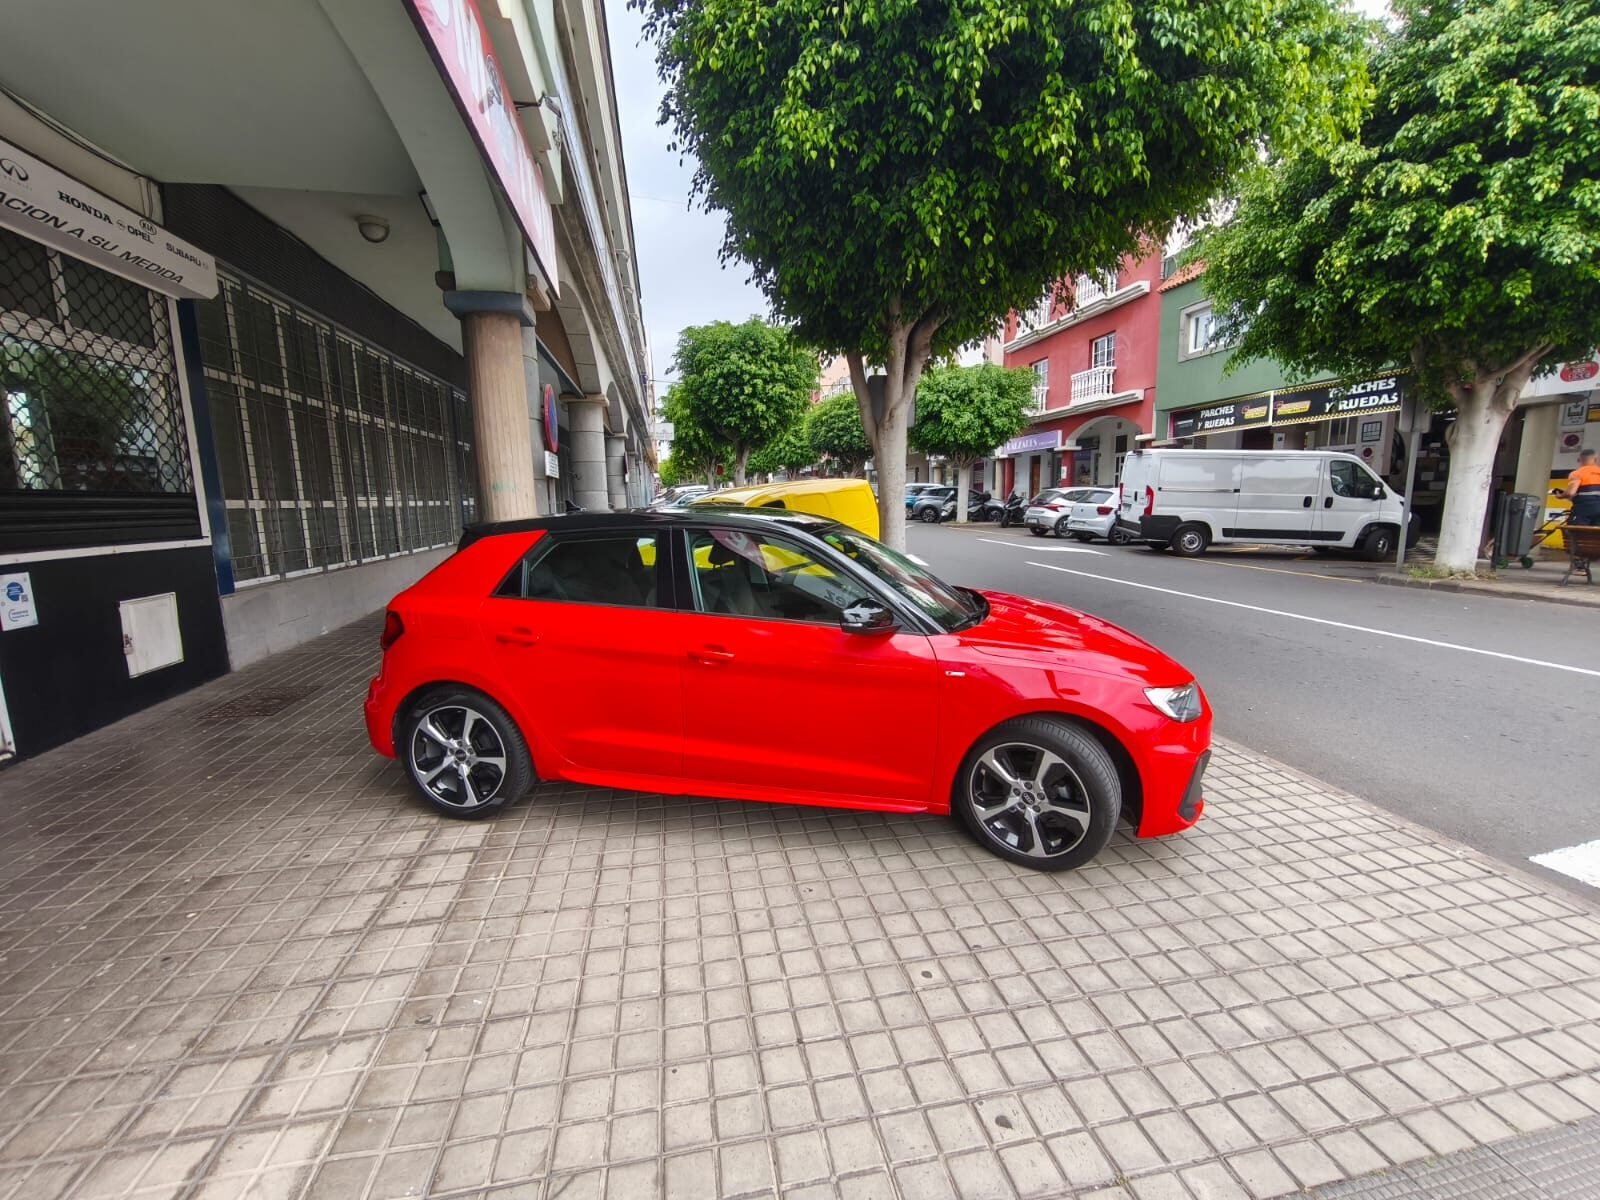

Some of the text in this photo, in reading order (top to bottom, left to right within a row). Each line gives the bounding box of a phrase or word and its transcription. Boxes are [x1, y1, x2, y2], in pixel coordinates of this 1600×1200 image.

[57, 190, 113, 225] HONDA
[127, 225, 154, 245] OPEL
[66, 227, 85, 238] A
[87, 235, 119, 251] SU
[119, 250, 184, 284] MEDIDA
[165, 242, 202, 267] SUBARU
[1200, 404, 1235, 419] PARCHES
[1324, 402, 1335, 413] Y
[1338, 392, 1399, 410] RUEDAS
[1197, 421, 1203, 430] Y
[1204, 416, 1235, 429] RUEDAS
